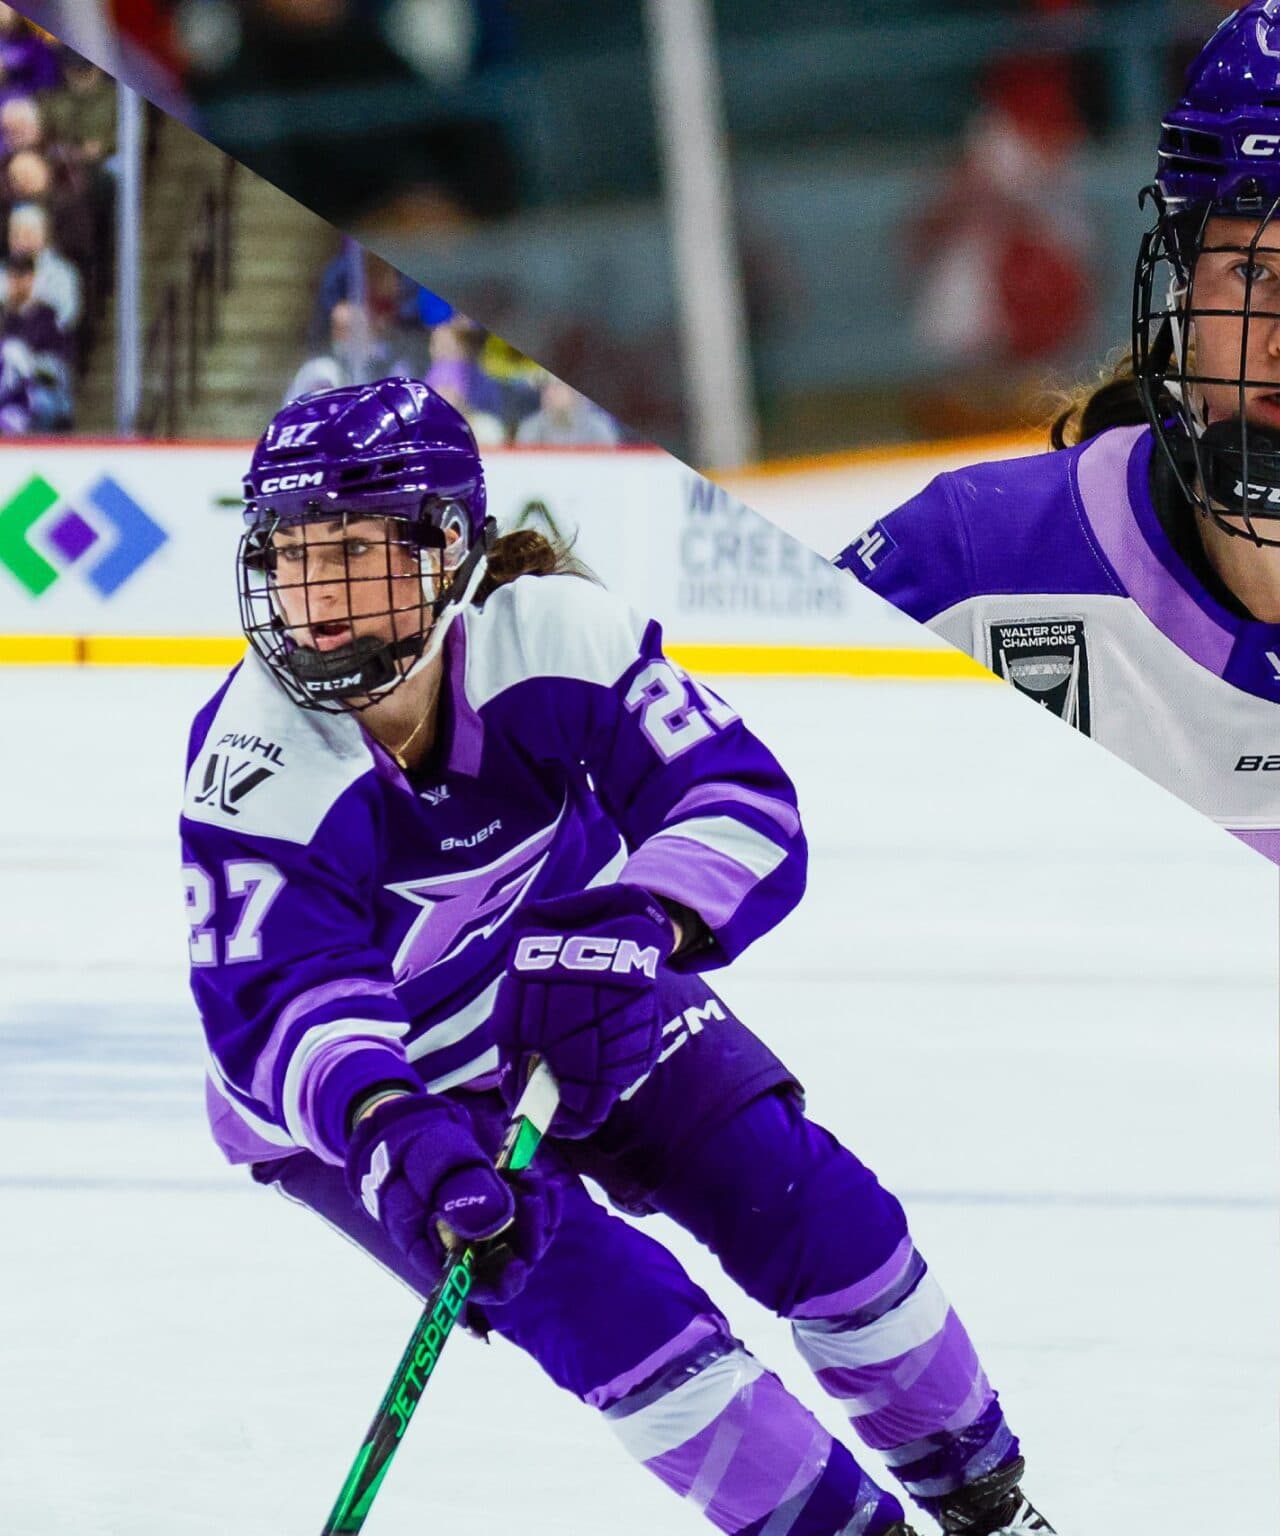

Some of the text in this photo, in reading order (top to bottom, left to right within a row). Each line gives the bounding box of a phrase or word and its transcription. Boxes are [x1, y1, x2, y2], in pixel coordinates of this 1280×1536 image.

[260, 471, 324, 494] CCM
[1000, 624, 1077, 639] WALTER CUP
[1002, 634, 1076, 649] CHAMPIONS
[216, 733, 286, 768] PWHL
[181, 858, 288, 968] 27
[513, 935, 660, 980] CCM
[444, 1195, 487, 1213] CCM
[388, 1263, 473, 1439] JETSPEED
